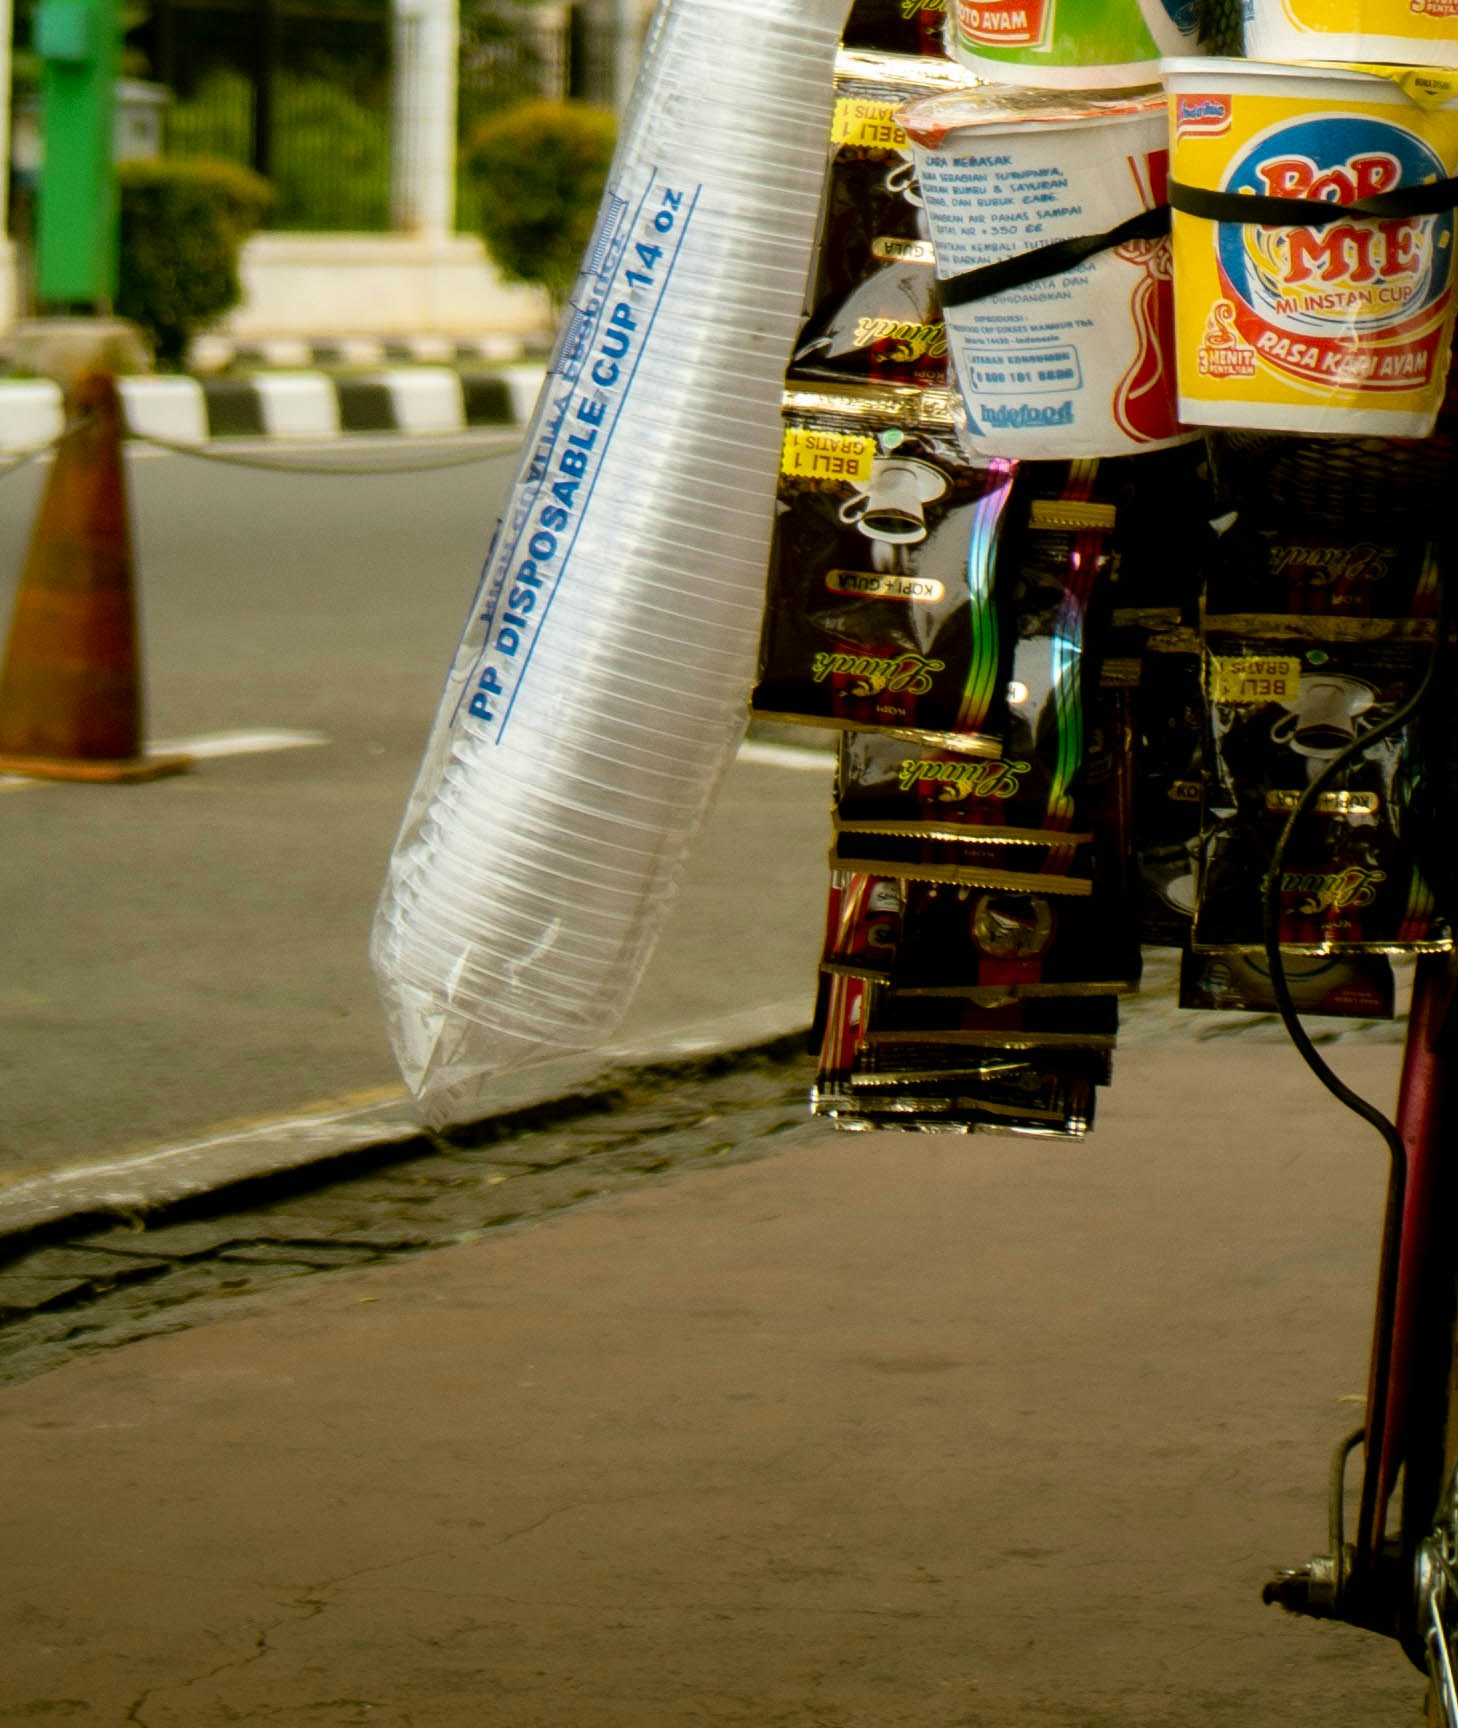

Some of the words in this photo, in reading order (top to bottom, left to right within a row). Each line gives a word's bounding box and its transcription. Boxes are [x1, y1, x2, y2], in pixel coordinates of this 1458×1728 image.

[982, 9, 1028, 31] AYAM
[860, 123, 907, 145] BELI
[1285, 217, 1421, 285] MIE
[1275, 297, 1299, 315] MI
[1303, 289, 1373, 312] INSTAN
[1378, 285, 1413, 305] CUP
[1199, 353, 1211, 375] 3
[1210, 348, 1254, 366] MENIT
[1256, 330, 1320, 369] RASA
[1379, 350, 1428, 378] AYAM
[468, 665, 503, 722] PP
[494, 395, 608, 657] DISPOSABLE
[591, 301, 638, 388] CUP
[624, 241, 664, 289] 14
[653, 187, 684, 234] oz
[805, 435, 865, 456] GRATIS
[812, 452, 860, 476] BELI
[837, 574, 881, 592] GULA
[901, 580, 934, 596] KOPI
[811, 651, 946, 695] Luwak
[898, 759, 1032, 799] Luwak
